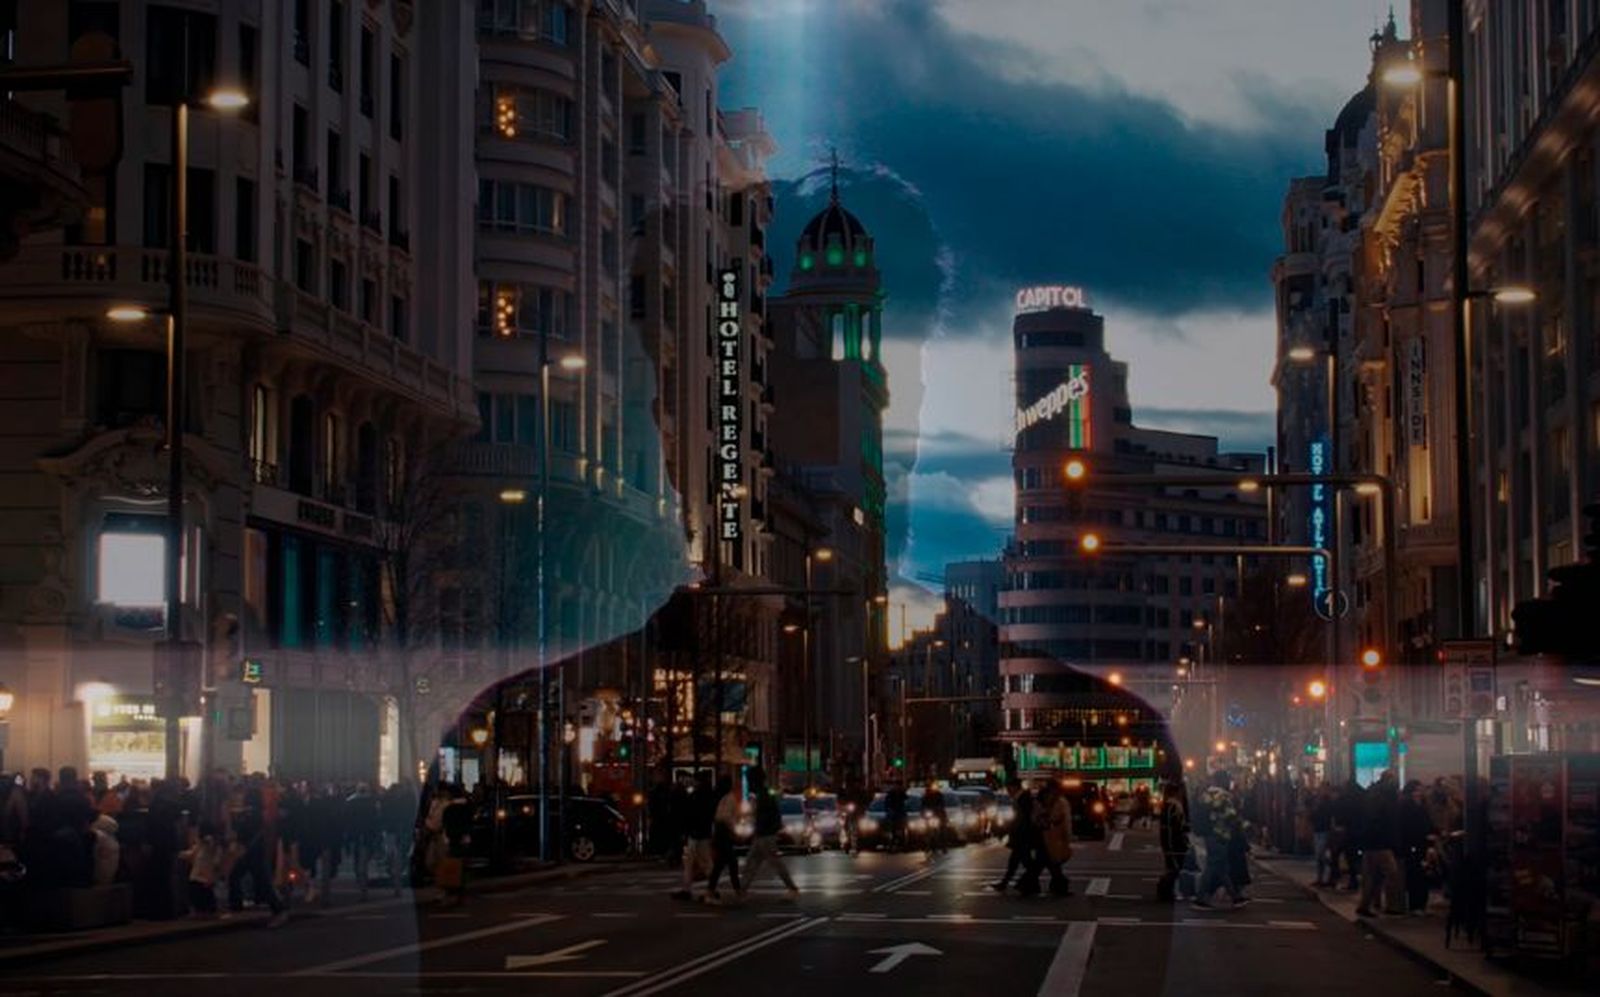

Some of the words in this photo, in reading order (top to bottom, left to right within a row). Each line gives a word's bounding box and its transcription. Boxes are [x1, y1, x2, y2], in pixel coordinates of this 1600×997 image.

[1016, 285, 1087, 309] CAPITOL
[720, 302, 740, 396] HOTEL
[720, 405, 739, 539] REGENTE
